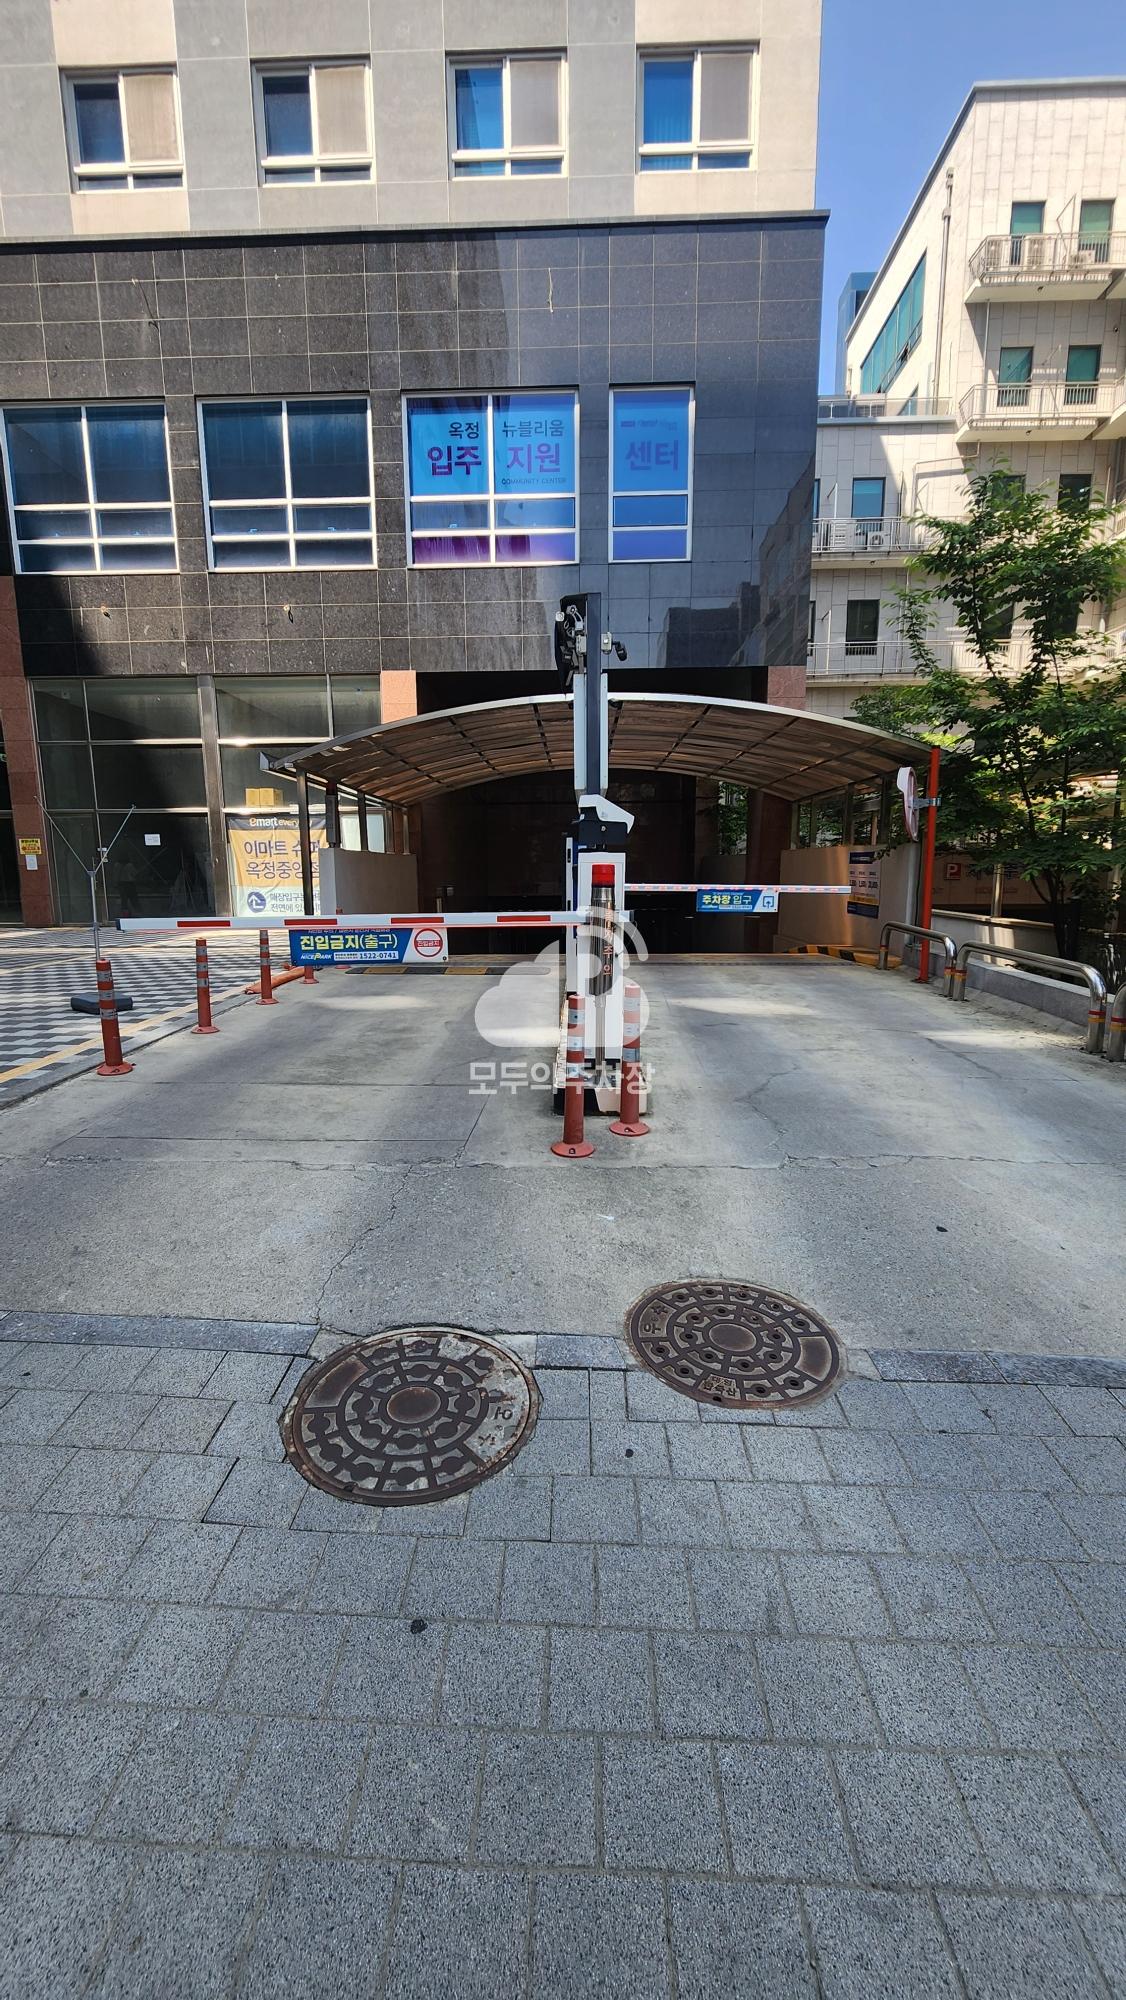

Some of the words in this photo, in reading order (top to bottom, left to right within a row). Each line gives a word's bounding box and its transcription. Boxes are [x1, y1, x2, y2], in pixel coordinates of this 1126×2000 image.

[449, 421, 480, 439] 옥정
[501, 419, 565, 437] 뉴블리움
[427, 445, 482, 476] 입주
[507, 443, 561, 474] 지원
[625, 439, 679, 473] 센터
[244, 840, 288, 858] 이마트
[946, 863, 958, 880] P
[702, 894, 731, 905] 주차장
[733, 895, 752, 905] 입구
[300, 933, 398, 950] 진입금지(출구)
[359, 952, 397, 960] 1522-0741
